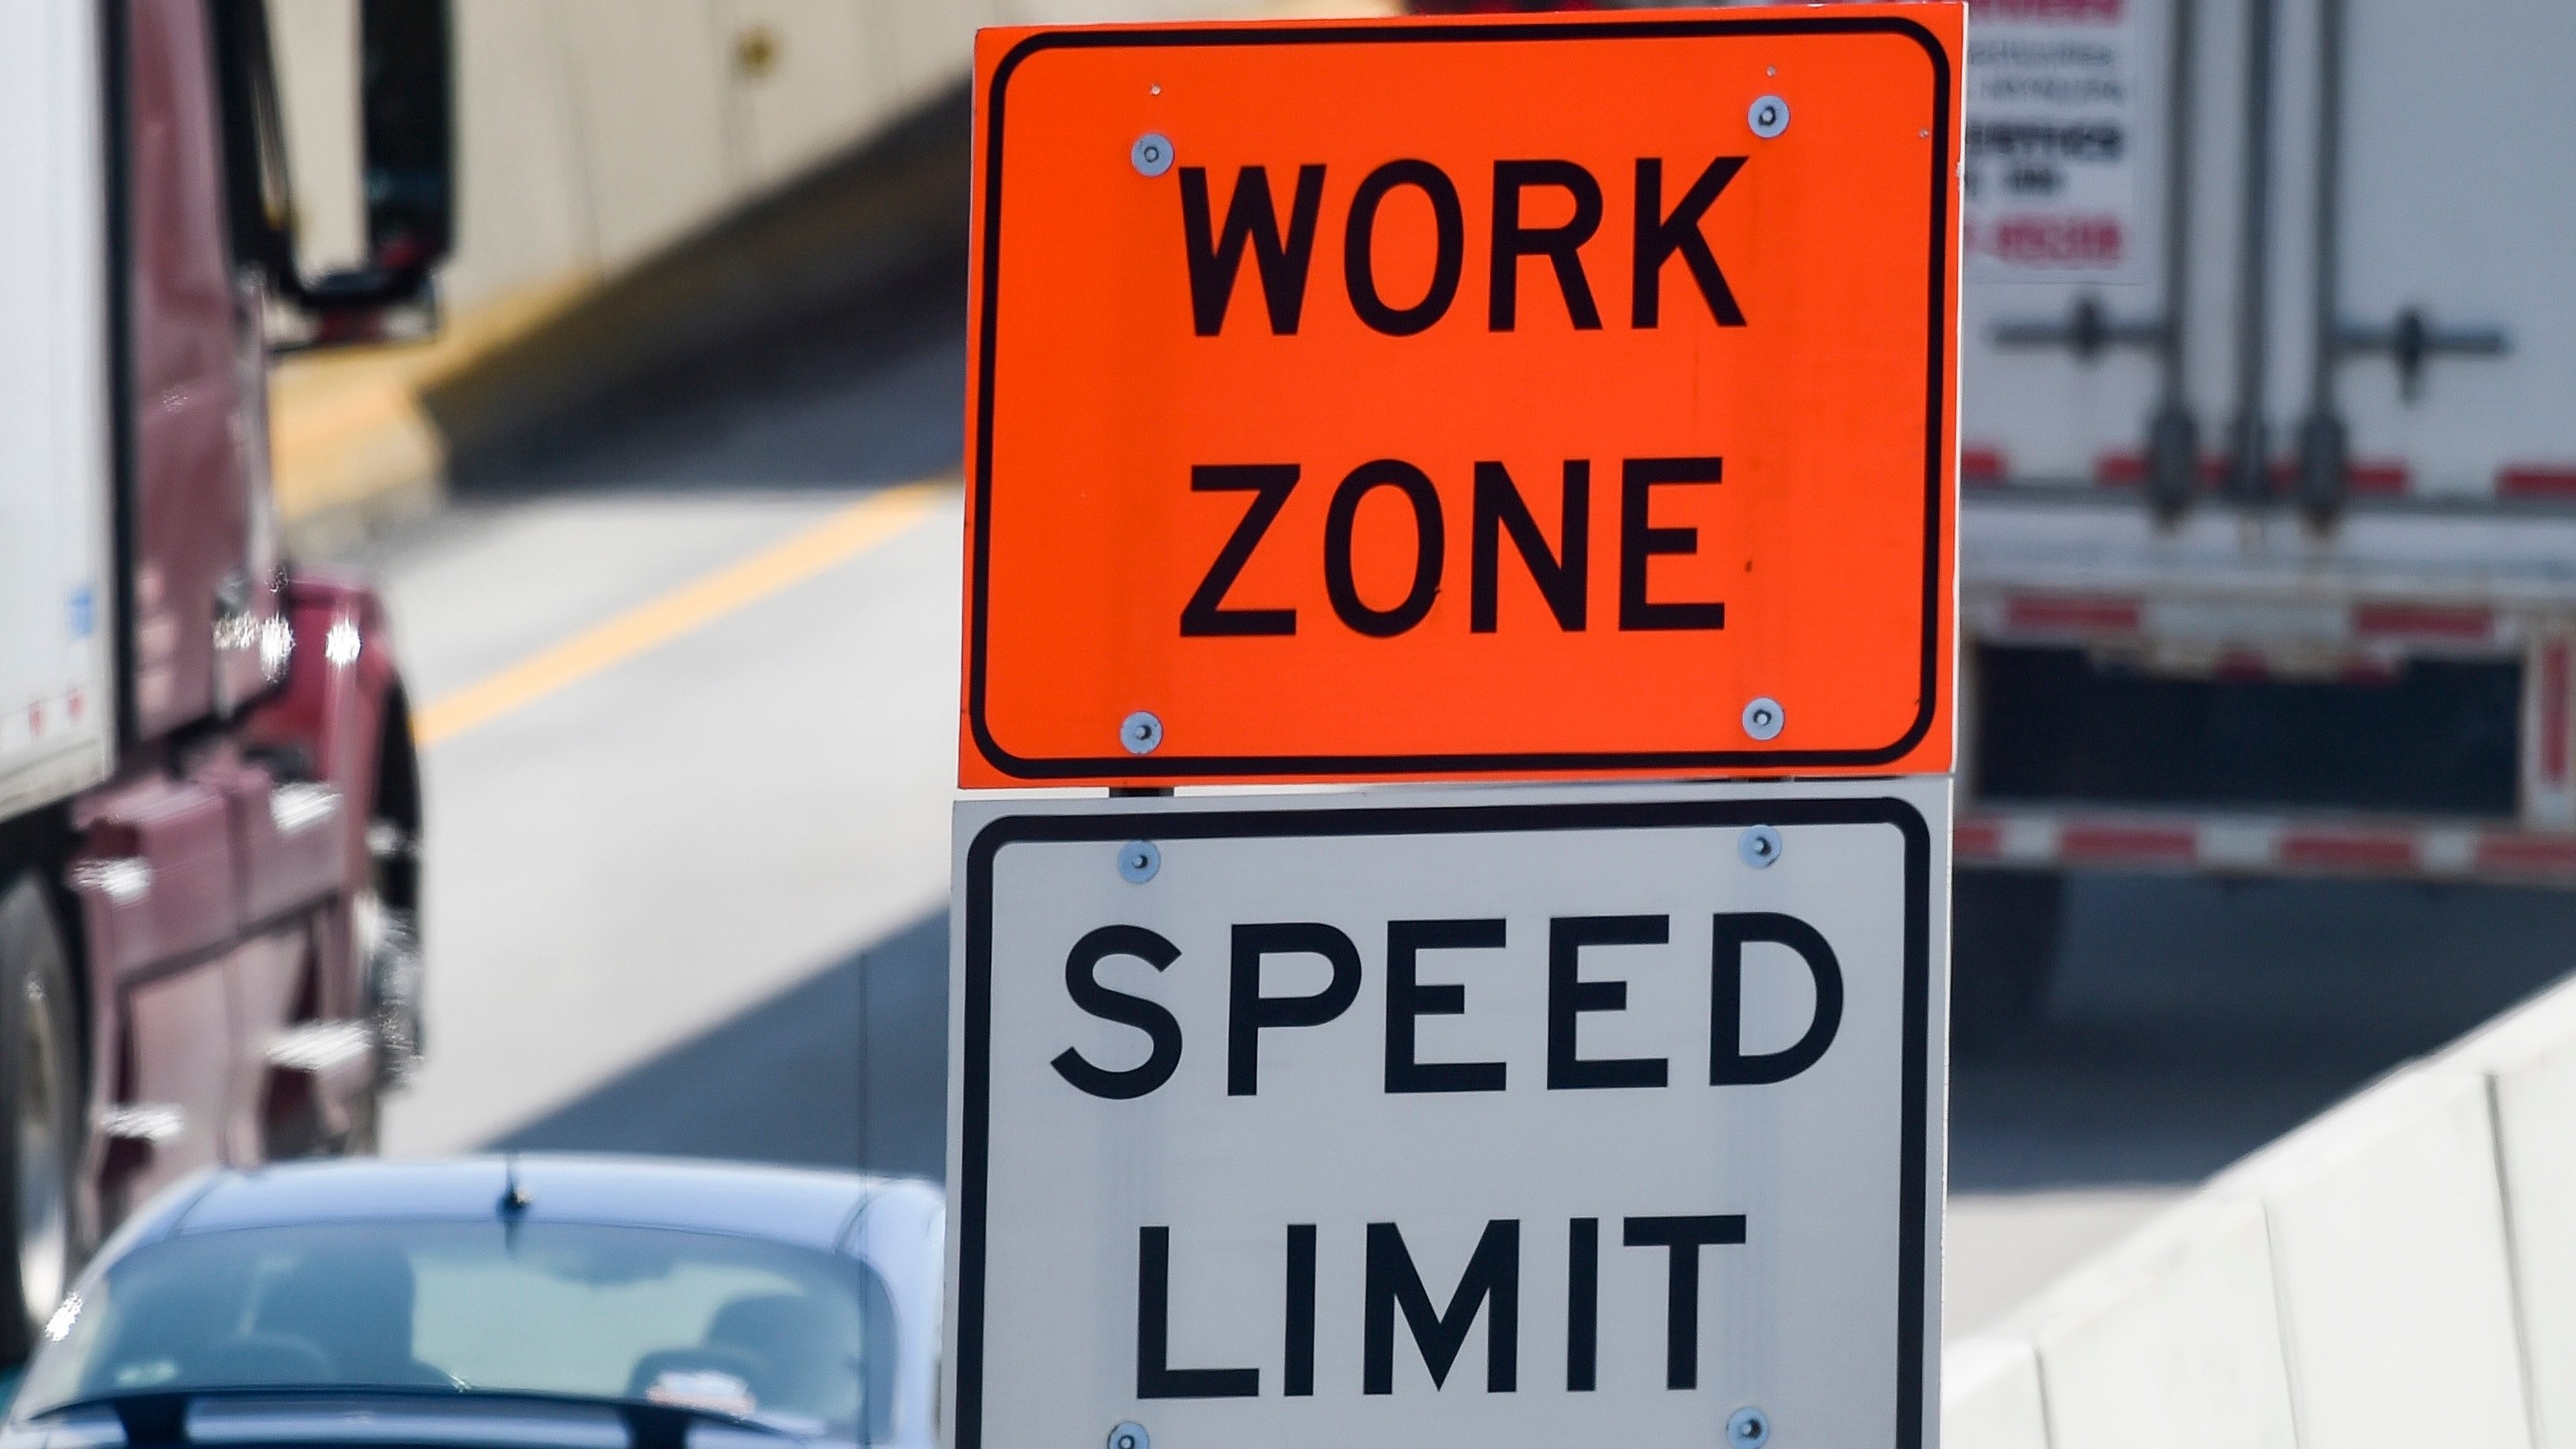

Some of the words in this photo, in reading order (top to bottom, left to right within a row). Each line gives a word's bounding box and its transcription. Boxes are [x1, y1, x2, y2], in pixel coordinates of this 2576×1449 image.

[1180, 157, 1747, 336] WORK
[1181, 458, 1724, 637] ZONE
[1051, 912, 1844, 1099] SPEED
[1137, 1215, 1747, 1399] LIMIT
